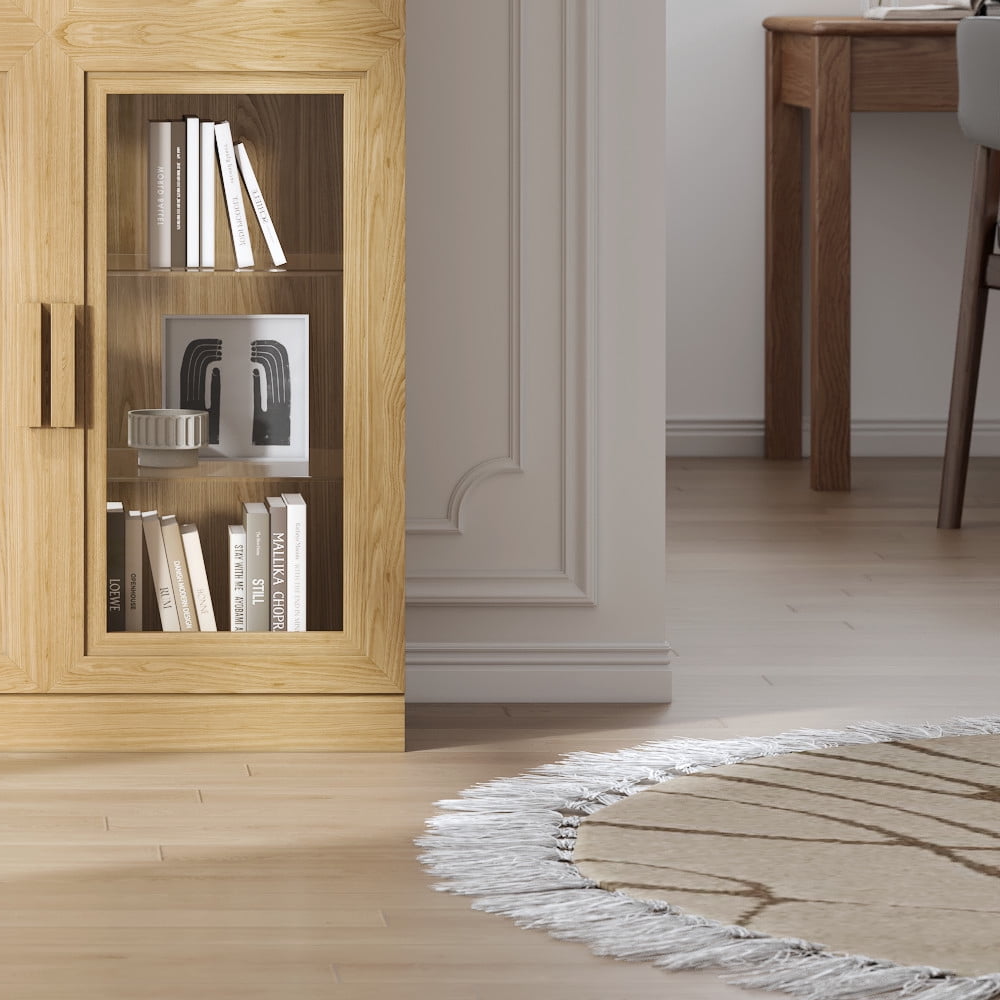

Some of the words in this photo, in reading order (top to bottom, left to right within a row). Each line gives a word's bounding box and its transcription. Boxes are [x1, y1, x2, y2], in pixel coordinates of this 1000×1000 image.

[234, 544, 243, 560] STAY
[273, 532, 284, 586] MALLIKA
[234, 562, 243, 578] WITH
[109, 579, 120, 612] LOEWE
[234, 581, 243, 591] ME
[252, 578, 264, 605] STILL
[235, 596, 243, 625] AYOBAMI
